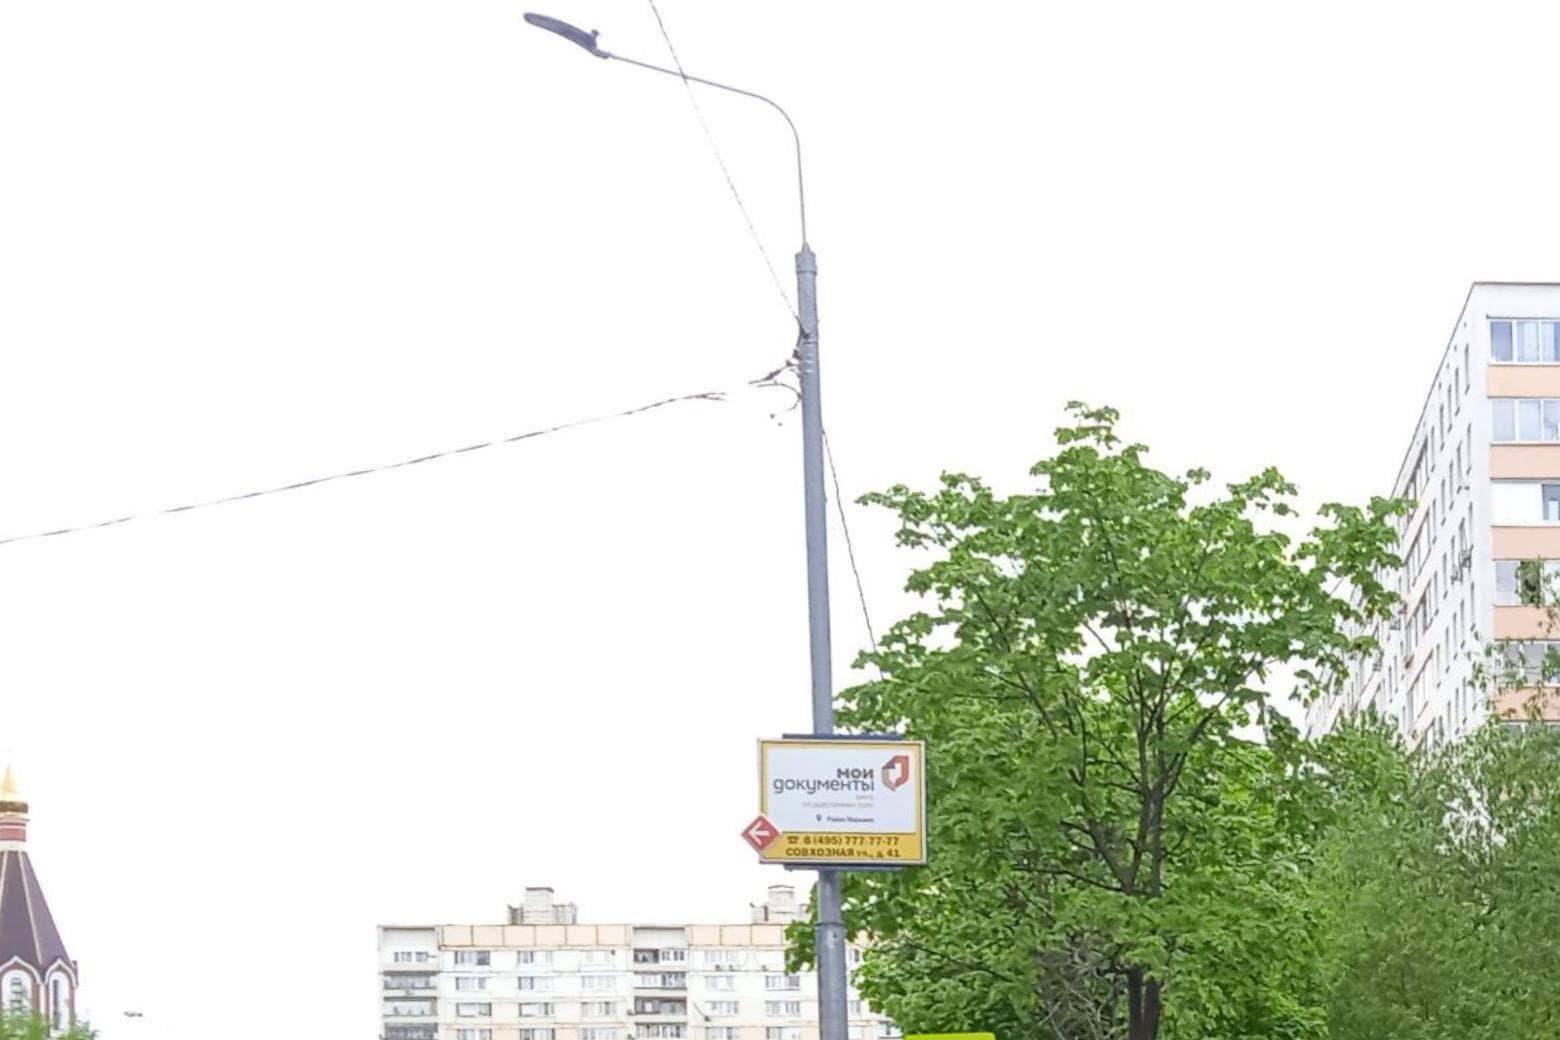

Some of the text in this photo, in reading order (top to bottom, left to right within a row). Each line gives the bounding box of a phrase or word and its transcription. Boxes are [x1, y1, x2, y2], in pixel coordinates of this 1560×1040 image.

[837, 768, 874, 779] мои
[773, 777, 874, 794] документы
[804, 836, 900, 846] 8 (495) 777 77-77
[785, 847, 855, 857] СОВХОЗНАЯ
